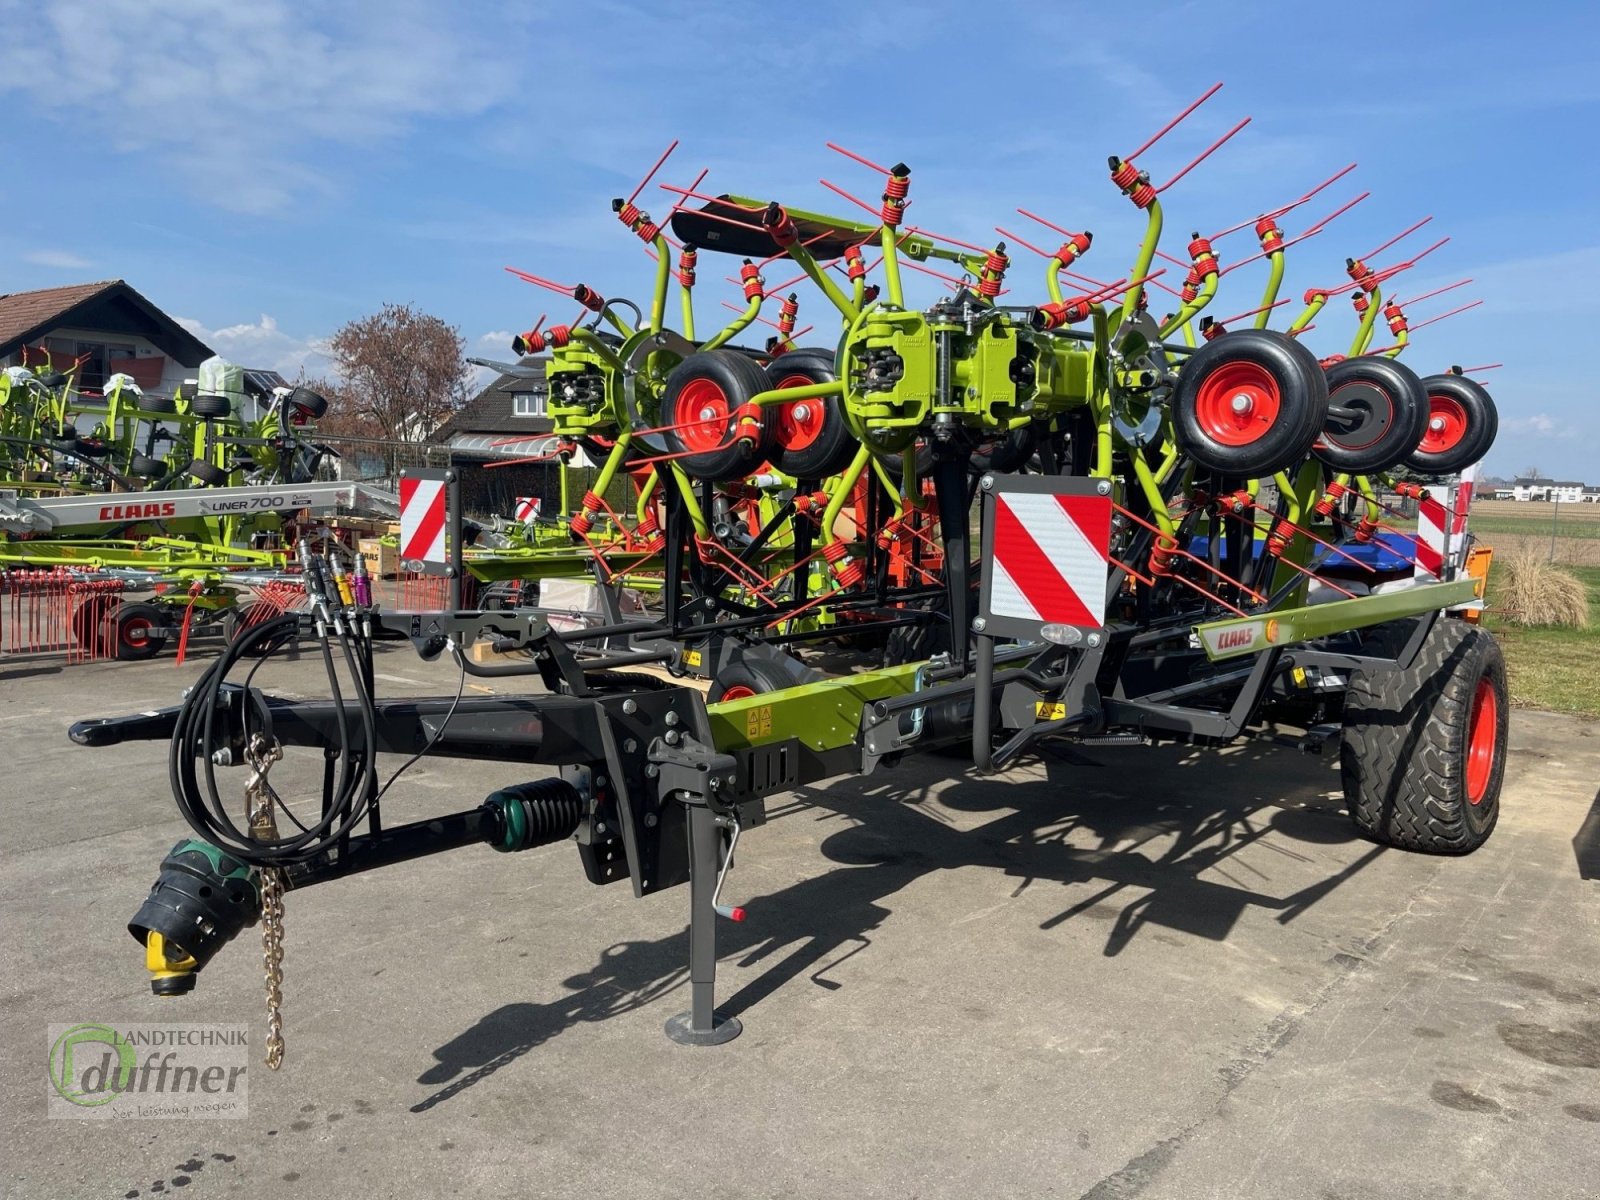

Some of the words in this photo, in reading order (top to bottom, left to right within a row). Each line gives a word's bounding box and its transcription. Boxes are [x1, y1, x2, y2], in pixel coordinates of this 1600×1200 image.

[99, 502, 176, 521] CLAAS
[212, 501, 248, 511] LINER
[250, 496, 285, 509] 700
[1217, 628, 1253, 650] CLAAS
